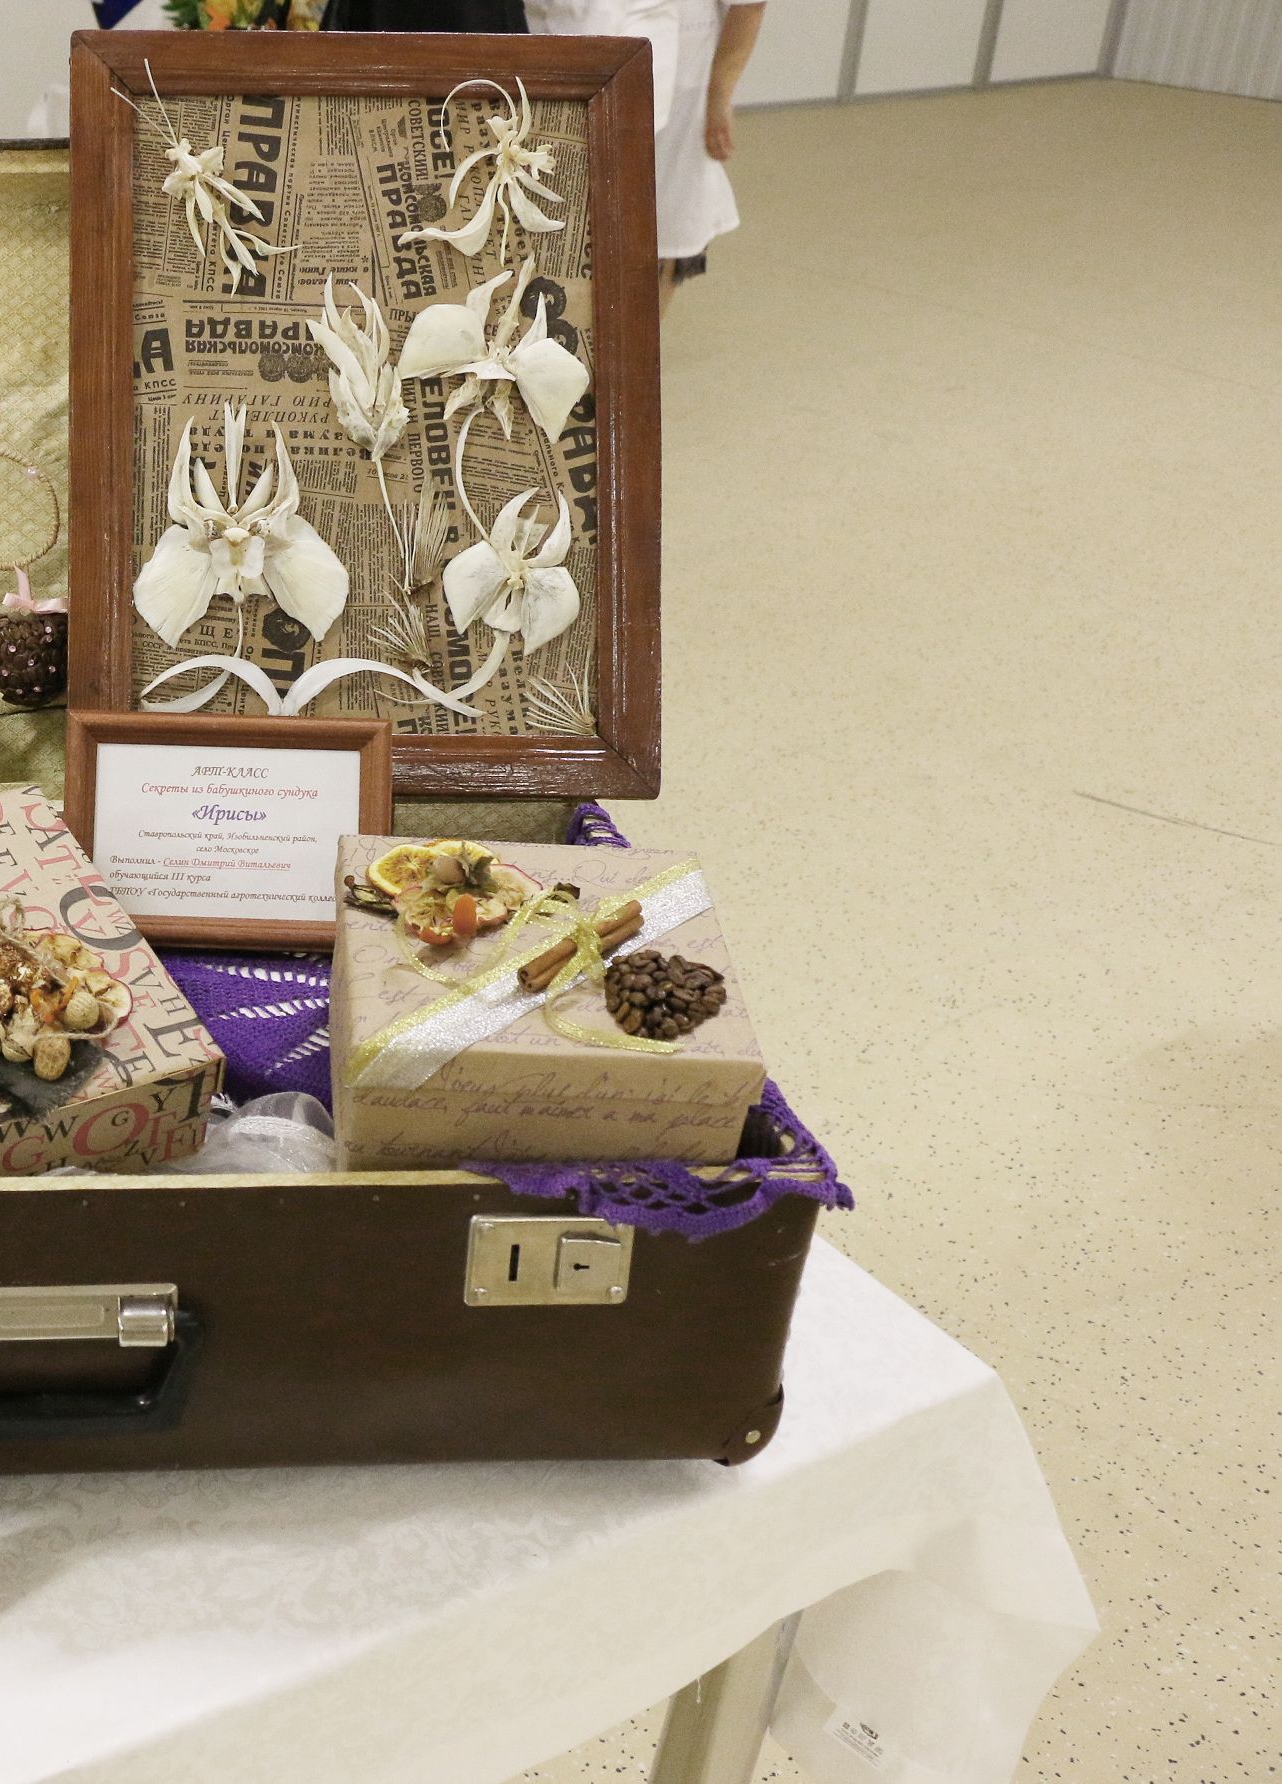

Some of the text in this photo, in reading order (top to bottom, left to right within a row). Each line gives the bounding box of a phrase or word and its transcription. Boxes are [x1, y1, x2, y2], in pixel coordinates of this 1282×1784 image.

[205, 260, 216, 292] КПСС
[145, 378, 177, 390] КПСС
[191, 765, 269, 779] АРТ-КЛАСС
[141, 783, 318, 799] Секреты из бабушкиного сундука
[191, 804, 267, 825] «Ирисы»
[214, 845, 259, 855] Московское
[110, 856, 291, 869] Выполнил Селин Дмитрий Витальевич
[110, 870, 168, 881] обучающийся
[187, 874, 211, 883] курса
